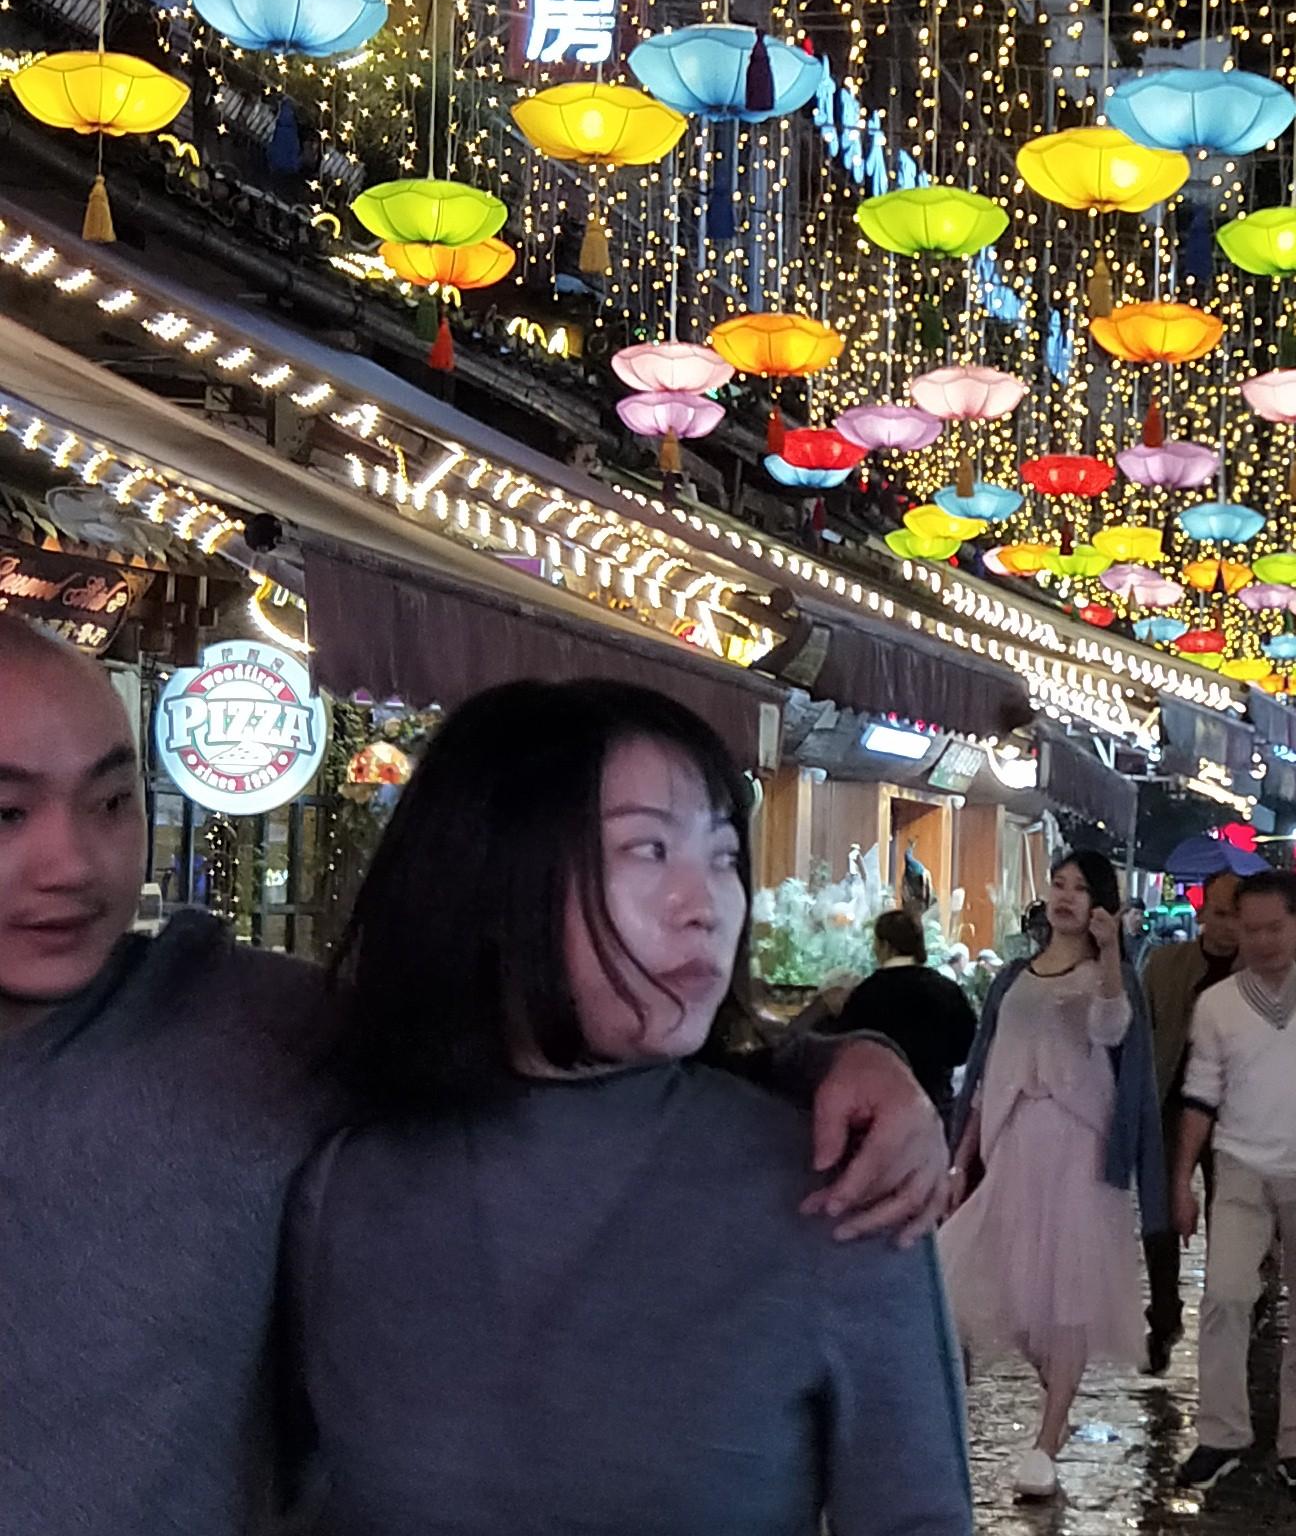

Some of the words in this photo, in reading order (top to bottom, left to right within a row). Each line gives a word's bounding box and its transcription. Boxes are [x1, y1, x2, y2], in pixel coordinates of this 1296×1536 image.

[200, 663, 286, 698] woodfired
[167, 696, 313, 752] PIZZA
[194, 764, 237, 791] since
